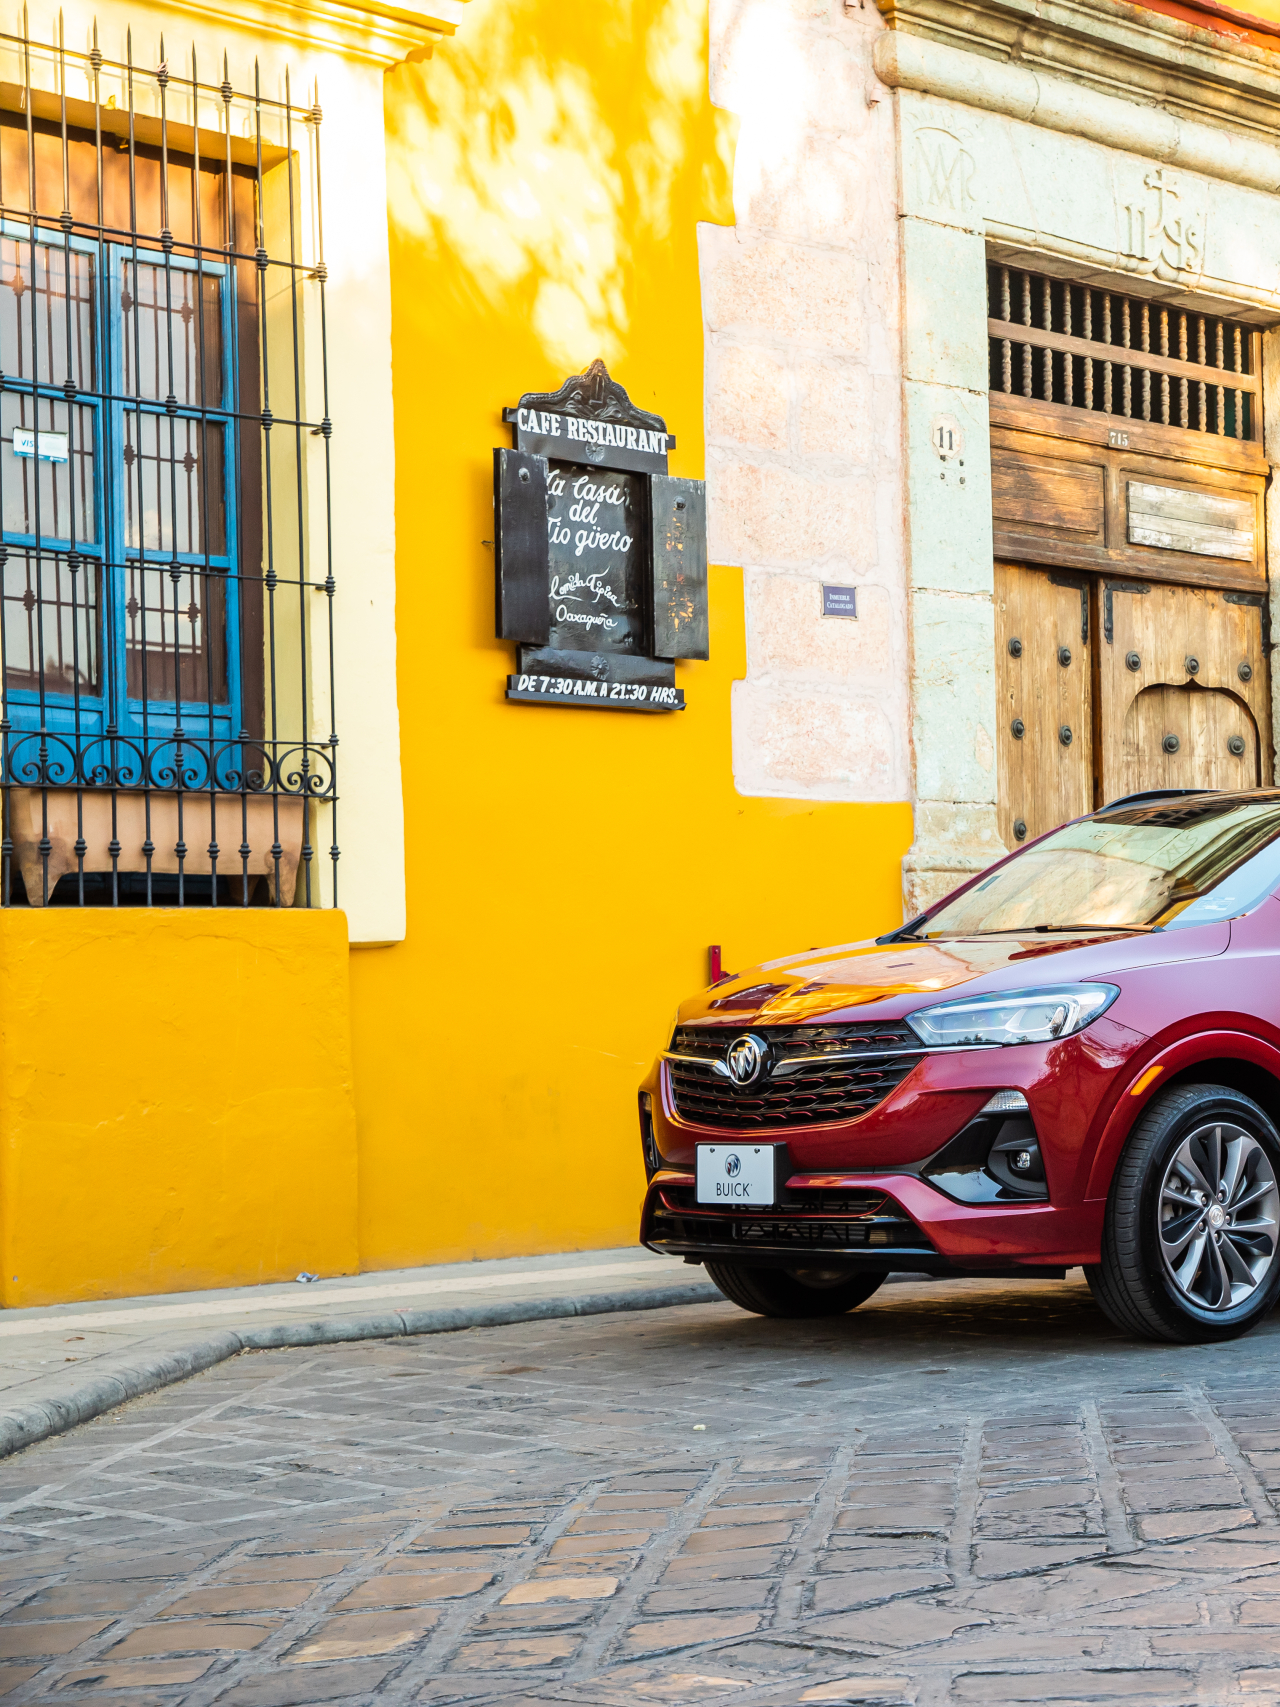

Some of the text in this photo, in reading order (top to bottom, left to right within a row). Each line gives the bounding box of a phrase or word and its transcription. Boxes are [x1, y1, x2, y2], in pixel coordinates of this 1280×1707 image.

[21, 439, 40, 450] VIS
[517, 408, 669, 455] CAFE RESTAURANT
[936, 426, 954, 451] 11
[1110, 431, 1129, 447] 715
[546, 469, 625, 505] La Casa
[568, 499, 600, 525] del
[575, 525, 634, 557] güero
[517, 674, 679, 704] DE 7:30 A.M. A 21:30 HRS.
[716, 1182, 750, 1197] BUICK
